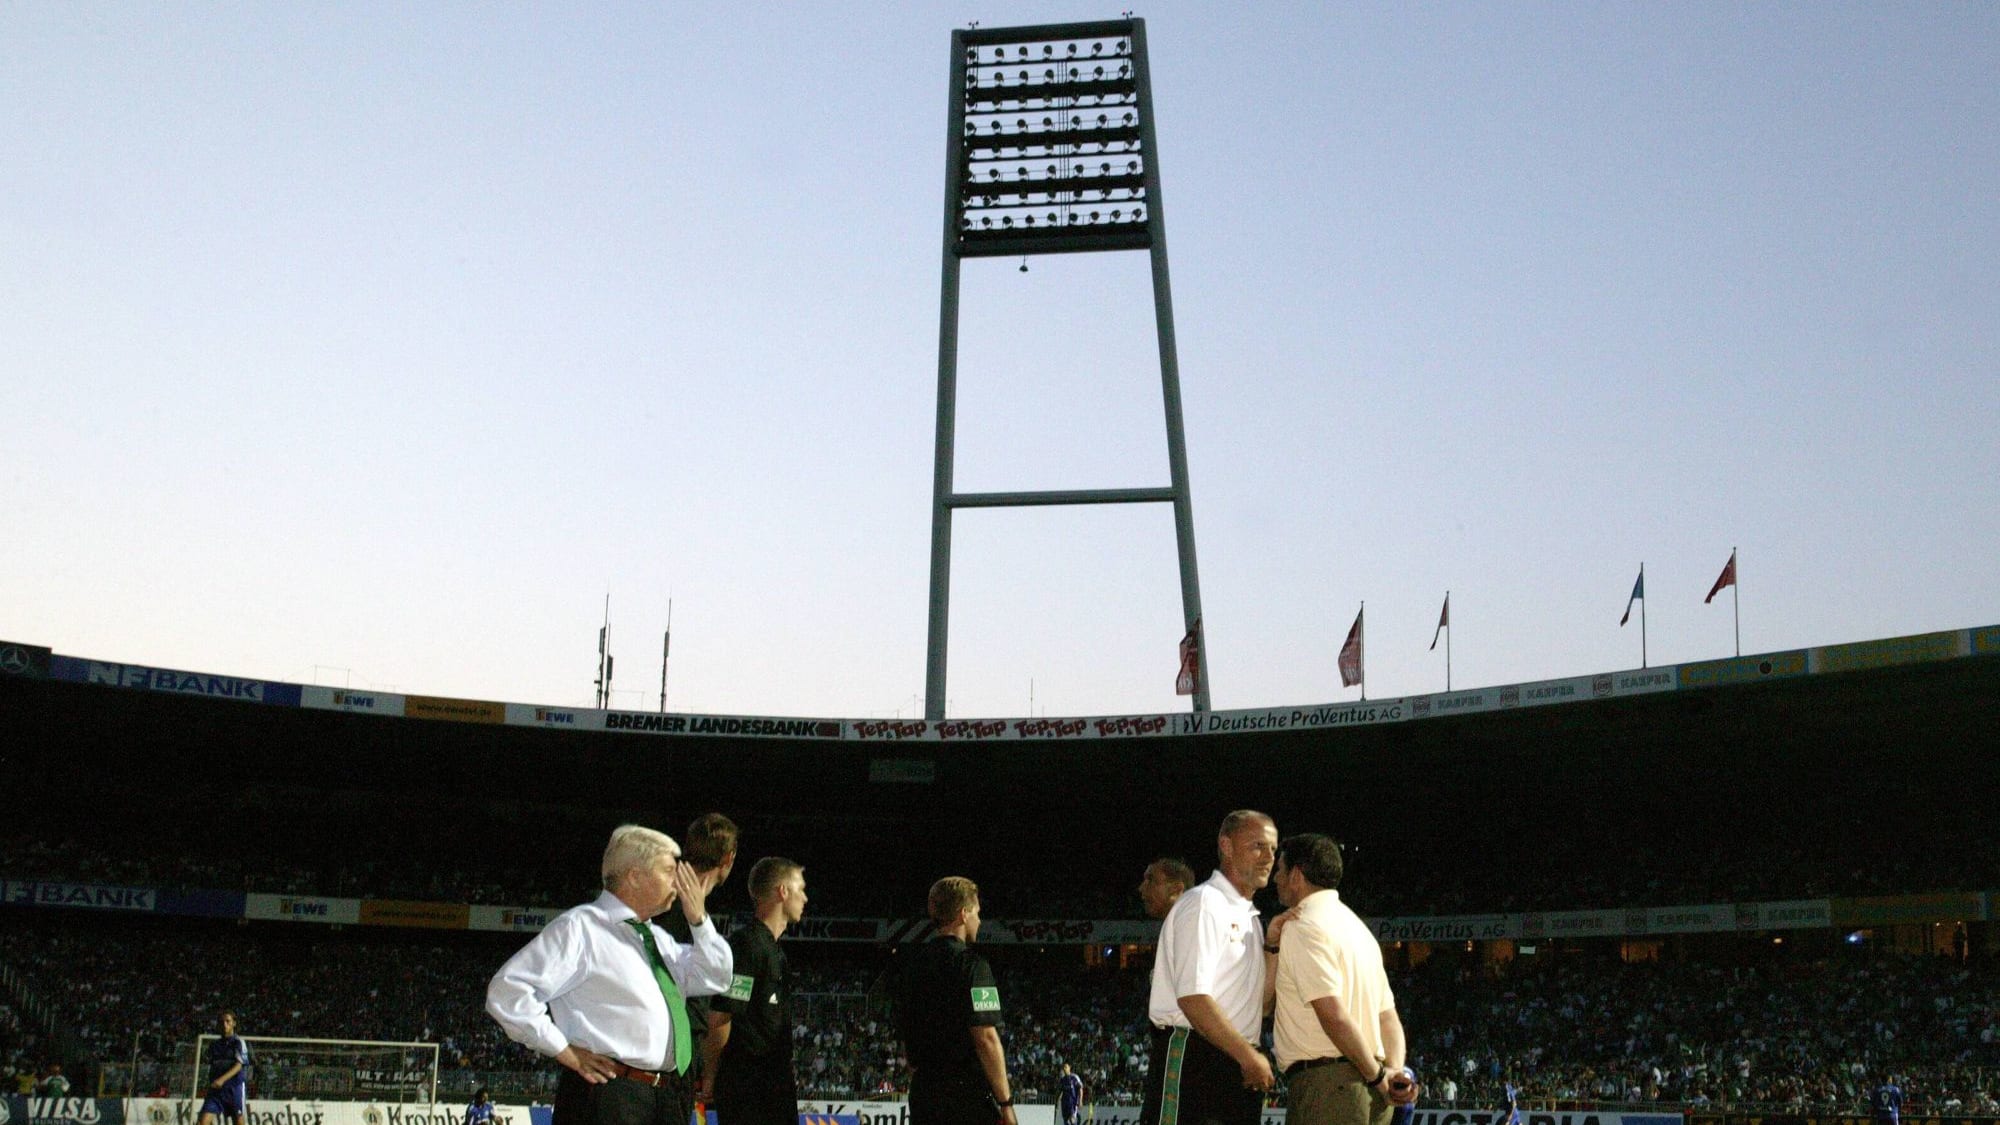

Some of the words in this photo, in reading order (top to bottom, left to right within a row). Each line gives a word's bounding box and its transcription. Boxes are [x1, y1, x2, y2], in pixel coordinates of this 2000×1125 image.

[545, 711, 574, 723] EWE
[605, 713, 686, 732] BREMER
[689, 718, 817, 737] LANDESBANK
[1093, 718, 1128, 736] Tep
[1129, 716, 1167, 736] Tap
[1208, 712, 1287, 731] Deutsche
[1290, 706, 1376, 727] ProVentus
[1379, 707, 1401, 720] AG
[852, 721, 889, 738] Tep
[890, 721, 927, 738] Tap
[934, 721, 969, 738] Tep
[970, 720, 1007, 738] Tap
[1013, 720, 1049, 738] Tep
[1050, 719, 1087, 737] Tap
[292, 903, 328, 915] EWE
[513, 914, 546, 926] EWE
[1378, 920, 1473, 938] ProVentus
[27, 1097, 95, 1119] VILSA
